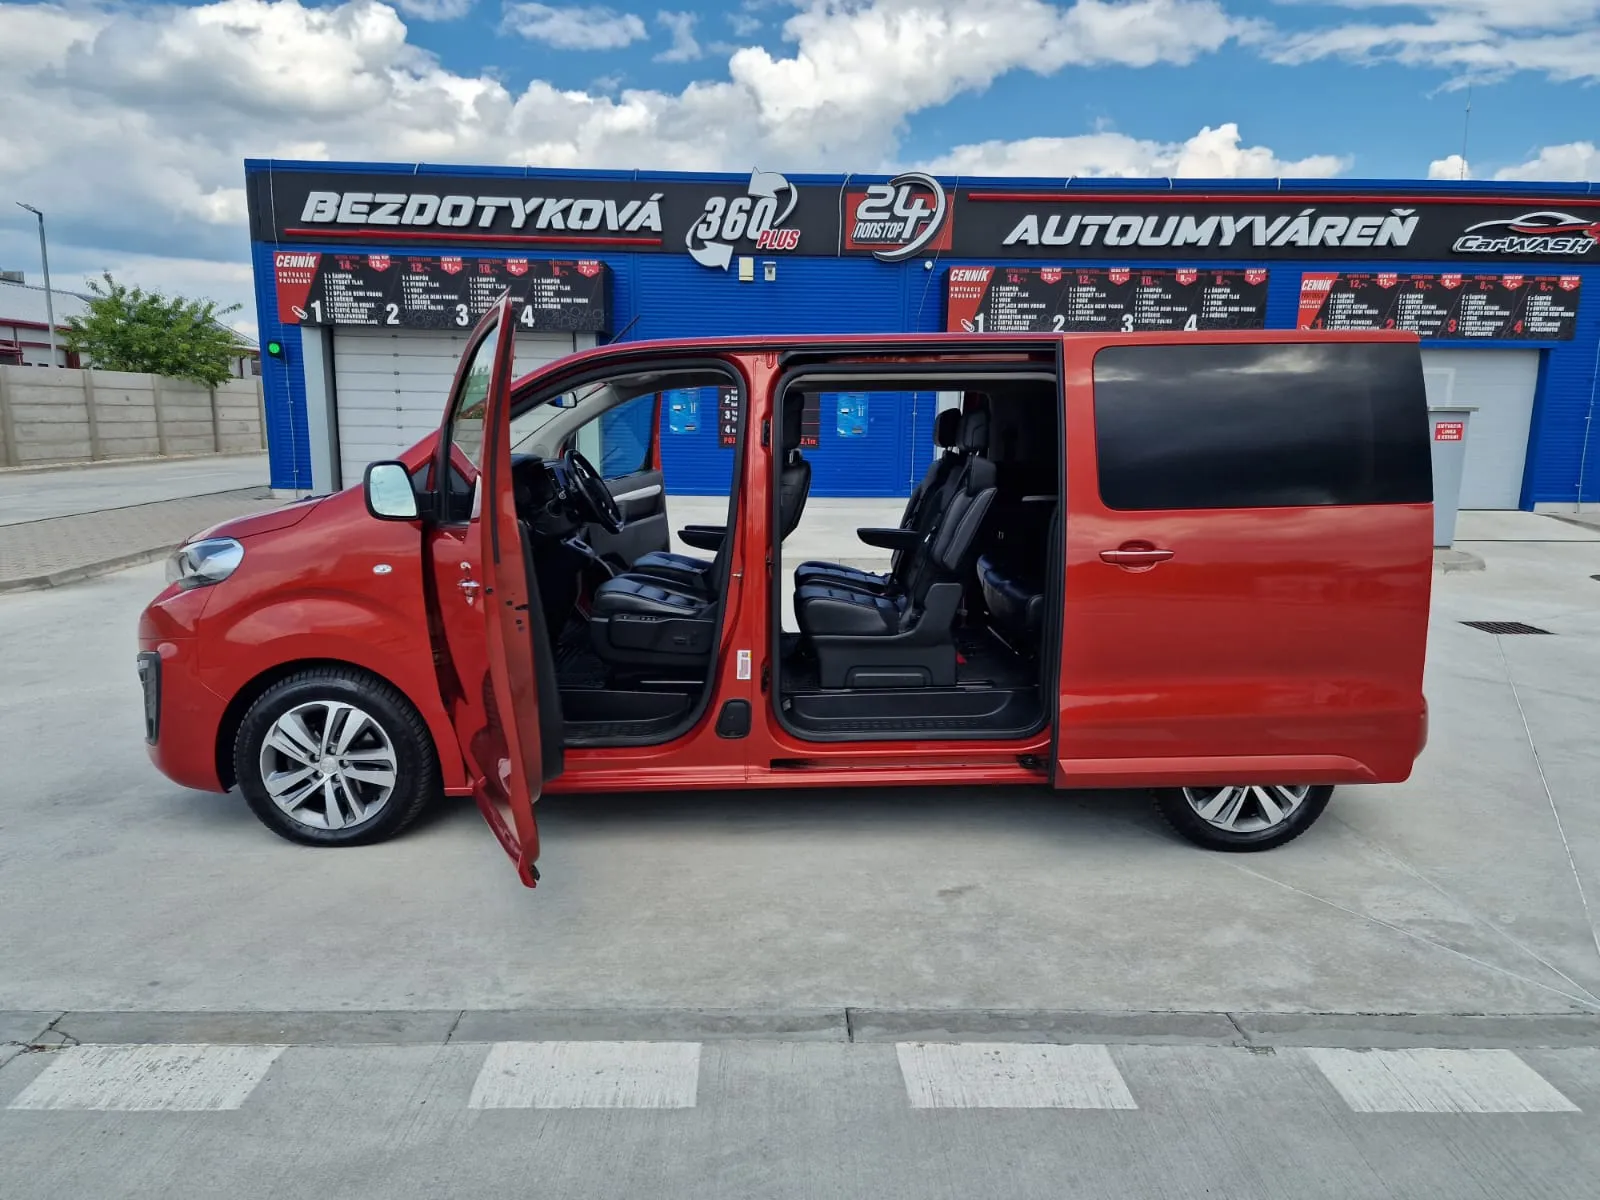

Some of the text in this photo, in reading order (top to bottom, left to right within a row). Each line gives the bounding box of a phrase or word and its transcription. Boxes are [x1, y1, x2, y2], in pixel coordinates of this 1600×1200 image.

[300, 192, 664, 233] BEZDOTYKOVÁ
[697, 196, 778, 241] 360
[856, 184, 932, 239] 24
[1002, 208, 1420, 248] AUTOUMYVÁREŇ
[756, 230, 800, 249] PLUS
[276, 253, 317, 269] CENNÍK
[950, 267, 990, 282] CENNÍK
[311, 300, 322, 323] 1
[386, 303, 400, 325] 2
[456, 304, 469, 326] 3
[521, 305, 535, 328] 4
[975, 313, 984, 332] 1
[1052, 314, 1065, 332] 2
[1121, 314, 1134, 332] 3
[1184, 314, 1198, 331] 4
[1385, 319, 1396, 330] 2
[1448, 319, 1458, 333] 3
[1513, 319, 1523, 334] 4
[724, 394, 731, 404] 2
[724, 410, 731, 420] 3
[724, 424, 731, 434] 4
